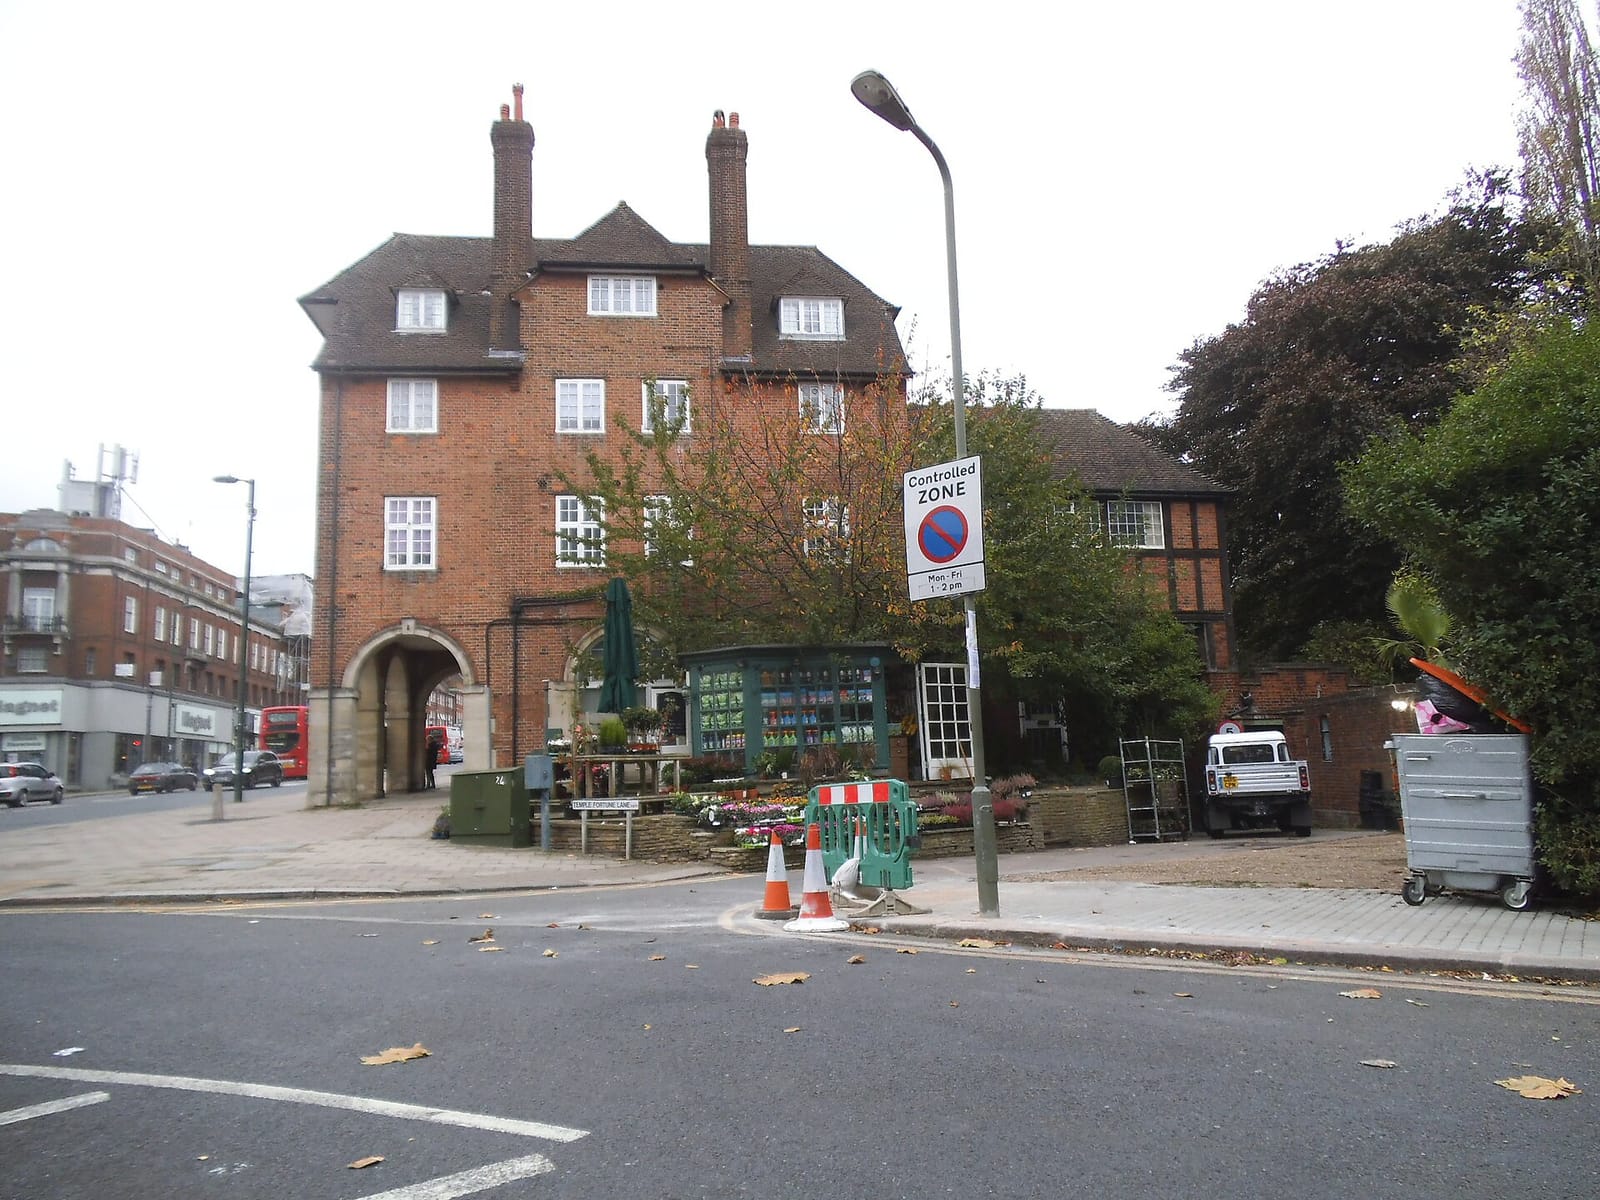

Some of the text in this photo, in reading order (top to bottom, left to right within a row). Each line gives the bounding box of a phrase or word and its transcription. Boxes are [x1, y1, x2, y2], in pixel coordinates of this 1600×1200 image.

[909, 462, 975, 488] Controlled
[918, 481, 966, 504] ZONE
[0, 700, 58, 716] agnet
